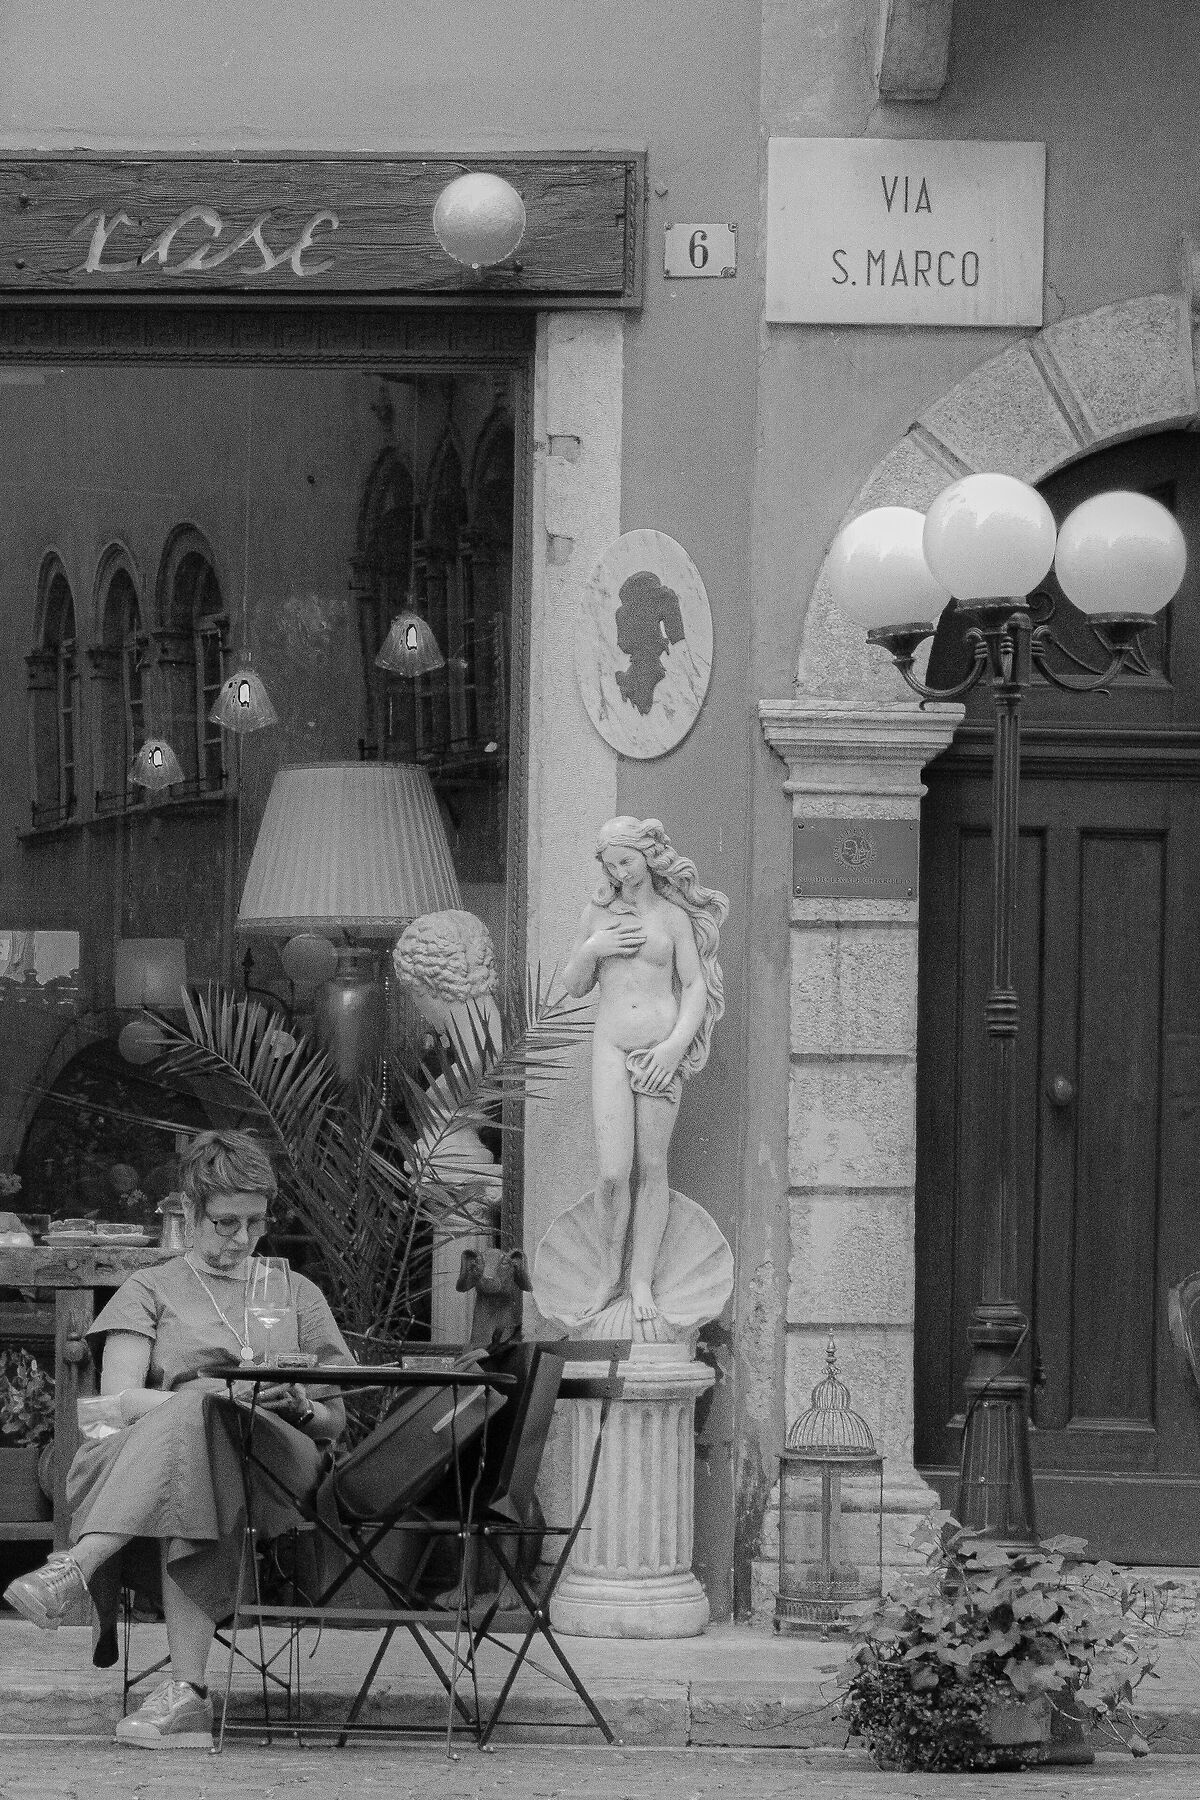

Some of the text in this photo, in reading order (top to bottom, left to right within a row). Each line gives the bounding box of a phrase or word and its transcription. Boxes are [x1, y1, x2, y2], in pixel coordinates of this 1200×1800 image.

[881, 175, 932, 213] VIA
[65, 204, 340, 277] rose
[688, 229, 709, 270] 6
